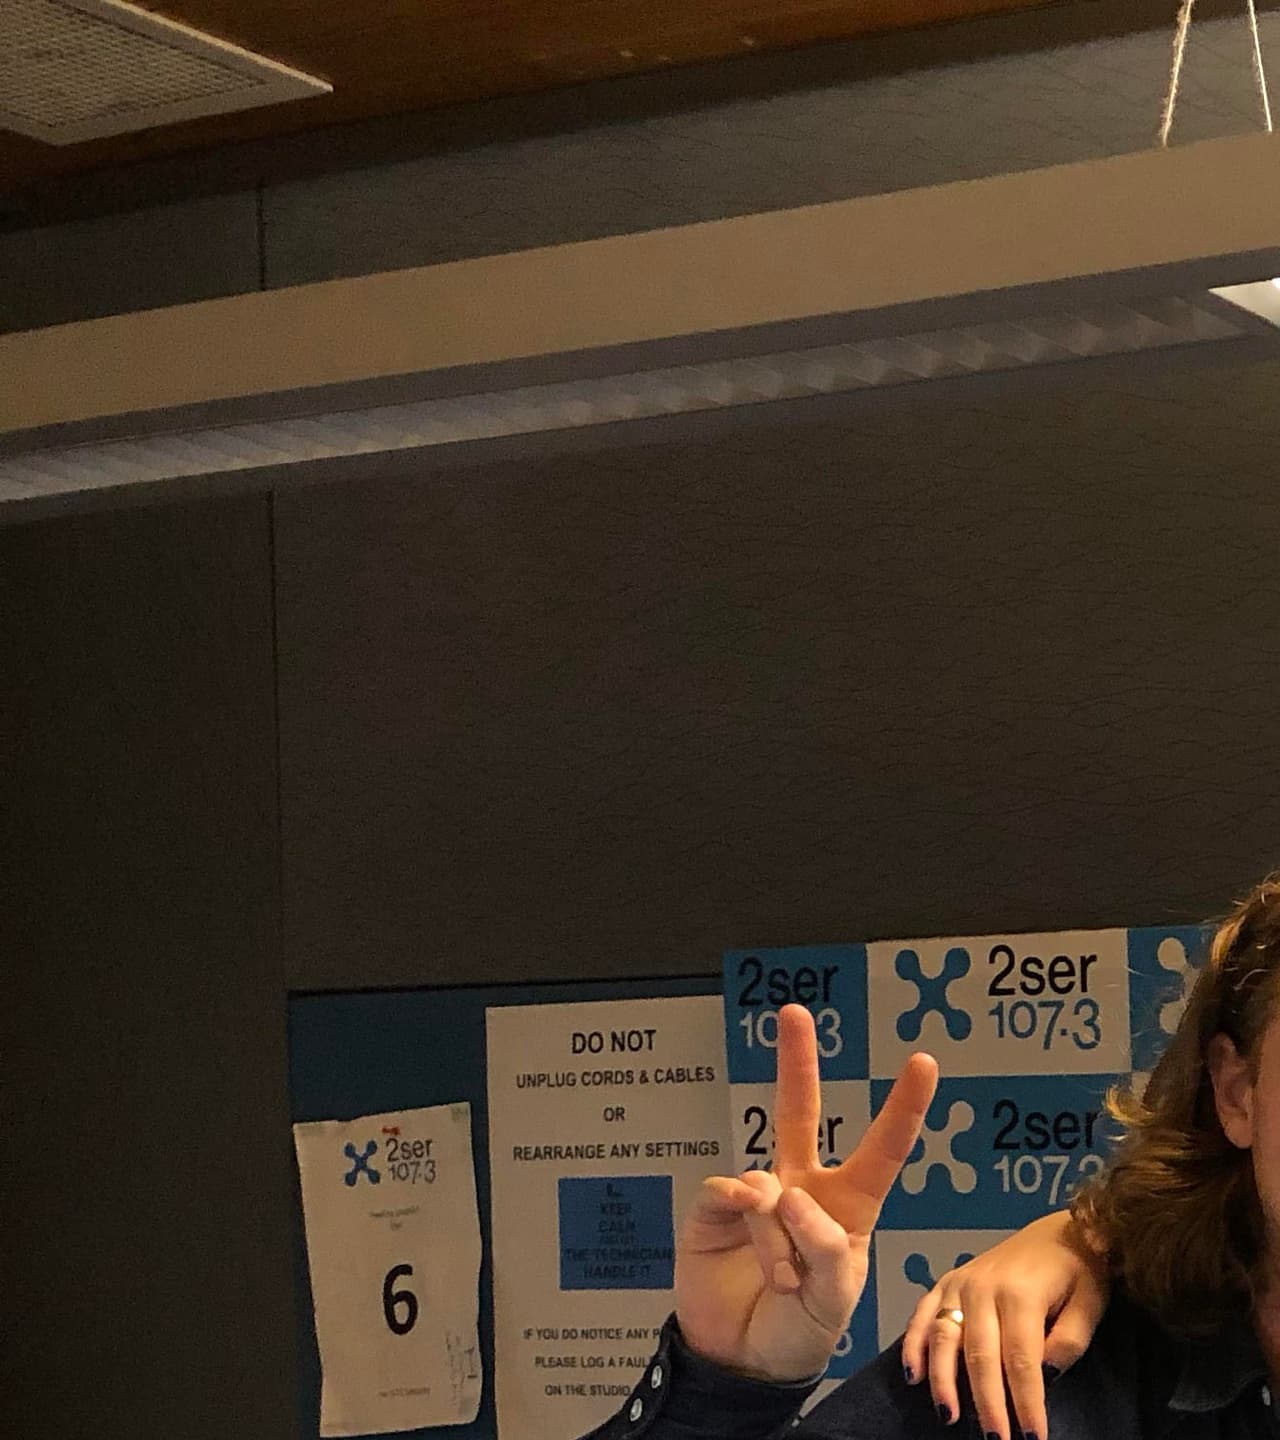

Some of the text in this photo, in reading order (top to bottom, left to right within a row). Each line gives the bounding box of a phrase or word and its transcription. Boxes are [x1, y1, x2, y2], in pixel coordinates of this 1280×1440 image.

[738, 957, 839, 1006] 2ser
[988, 944, 1097, 997] 2ser
[740, 1008, 843, 1058] 103
[989, 997, 1100, 1051] 107.3
[572, 1029, 657, 1054] DO NOT
[516, 1067, 715, 1088] UNPLUG CORDS & CABLES
[603, 1107, 625, 1122] OR
[992, 1099, 1100, 1150] 2ser
[744, 1106, 843, 1153] 2r
[386, 1138, 433, 1162] 2ser
[513, 1141, 720, 1161] REARRANGE ANY SETTINGS
[387, 1159, 437, 1184] 107.3
[382, 1263, 419, 1335] 6
[536, 1328, 558, 1340] YOU
[562, 1328, 578, 1340] DO
[581, 1328, 623, 1340] NOTICE
[626, 1328, 649, 1339] ANY
[535, 1356, 648, 1368] PLEASE LOG A FAUL
[545, 1385, 631, 1396] ON THE STUDIO
